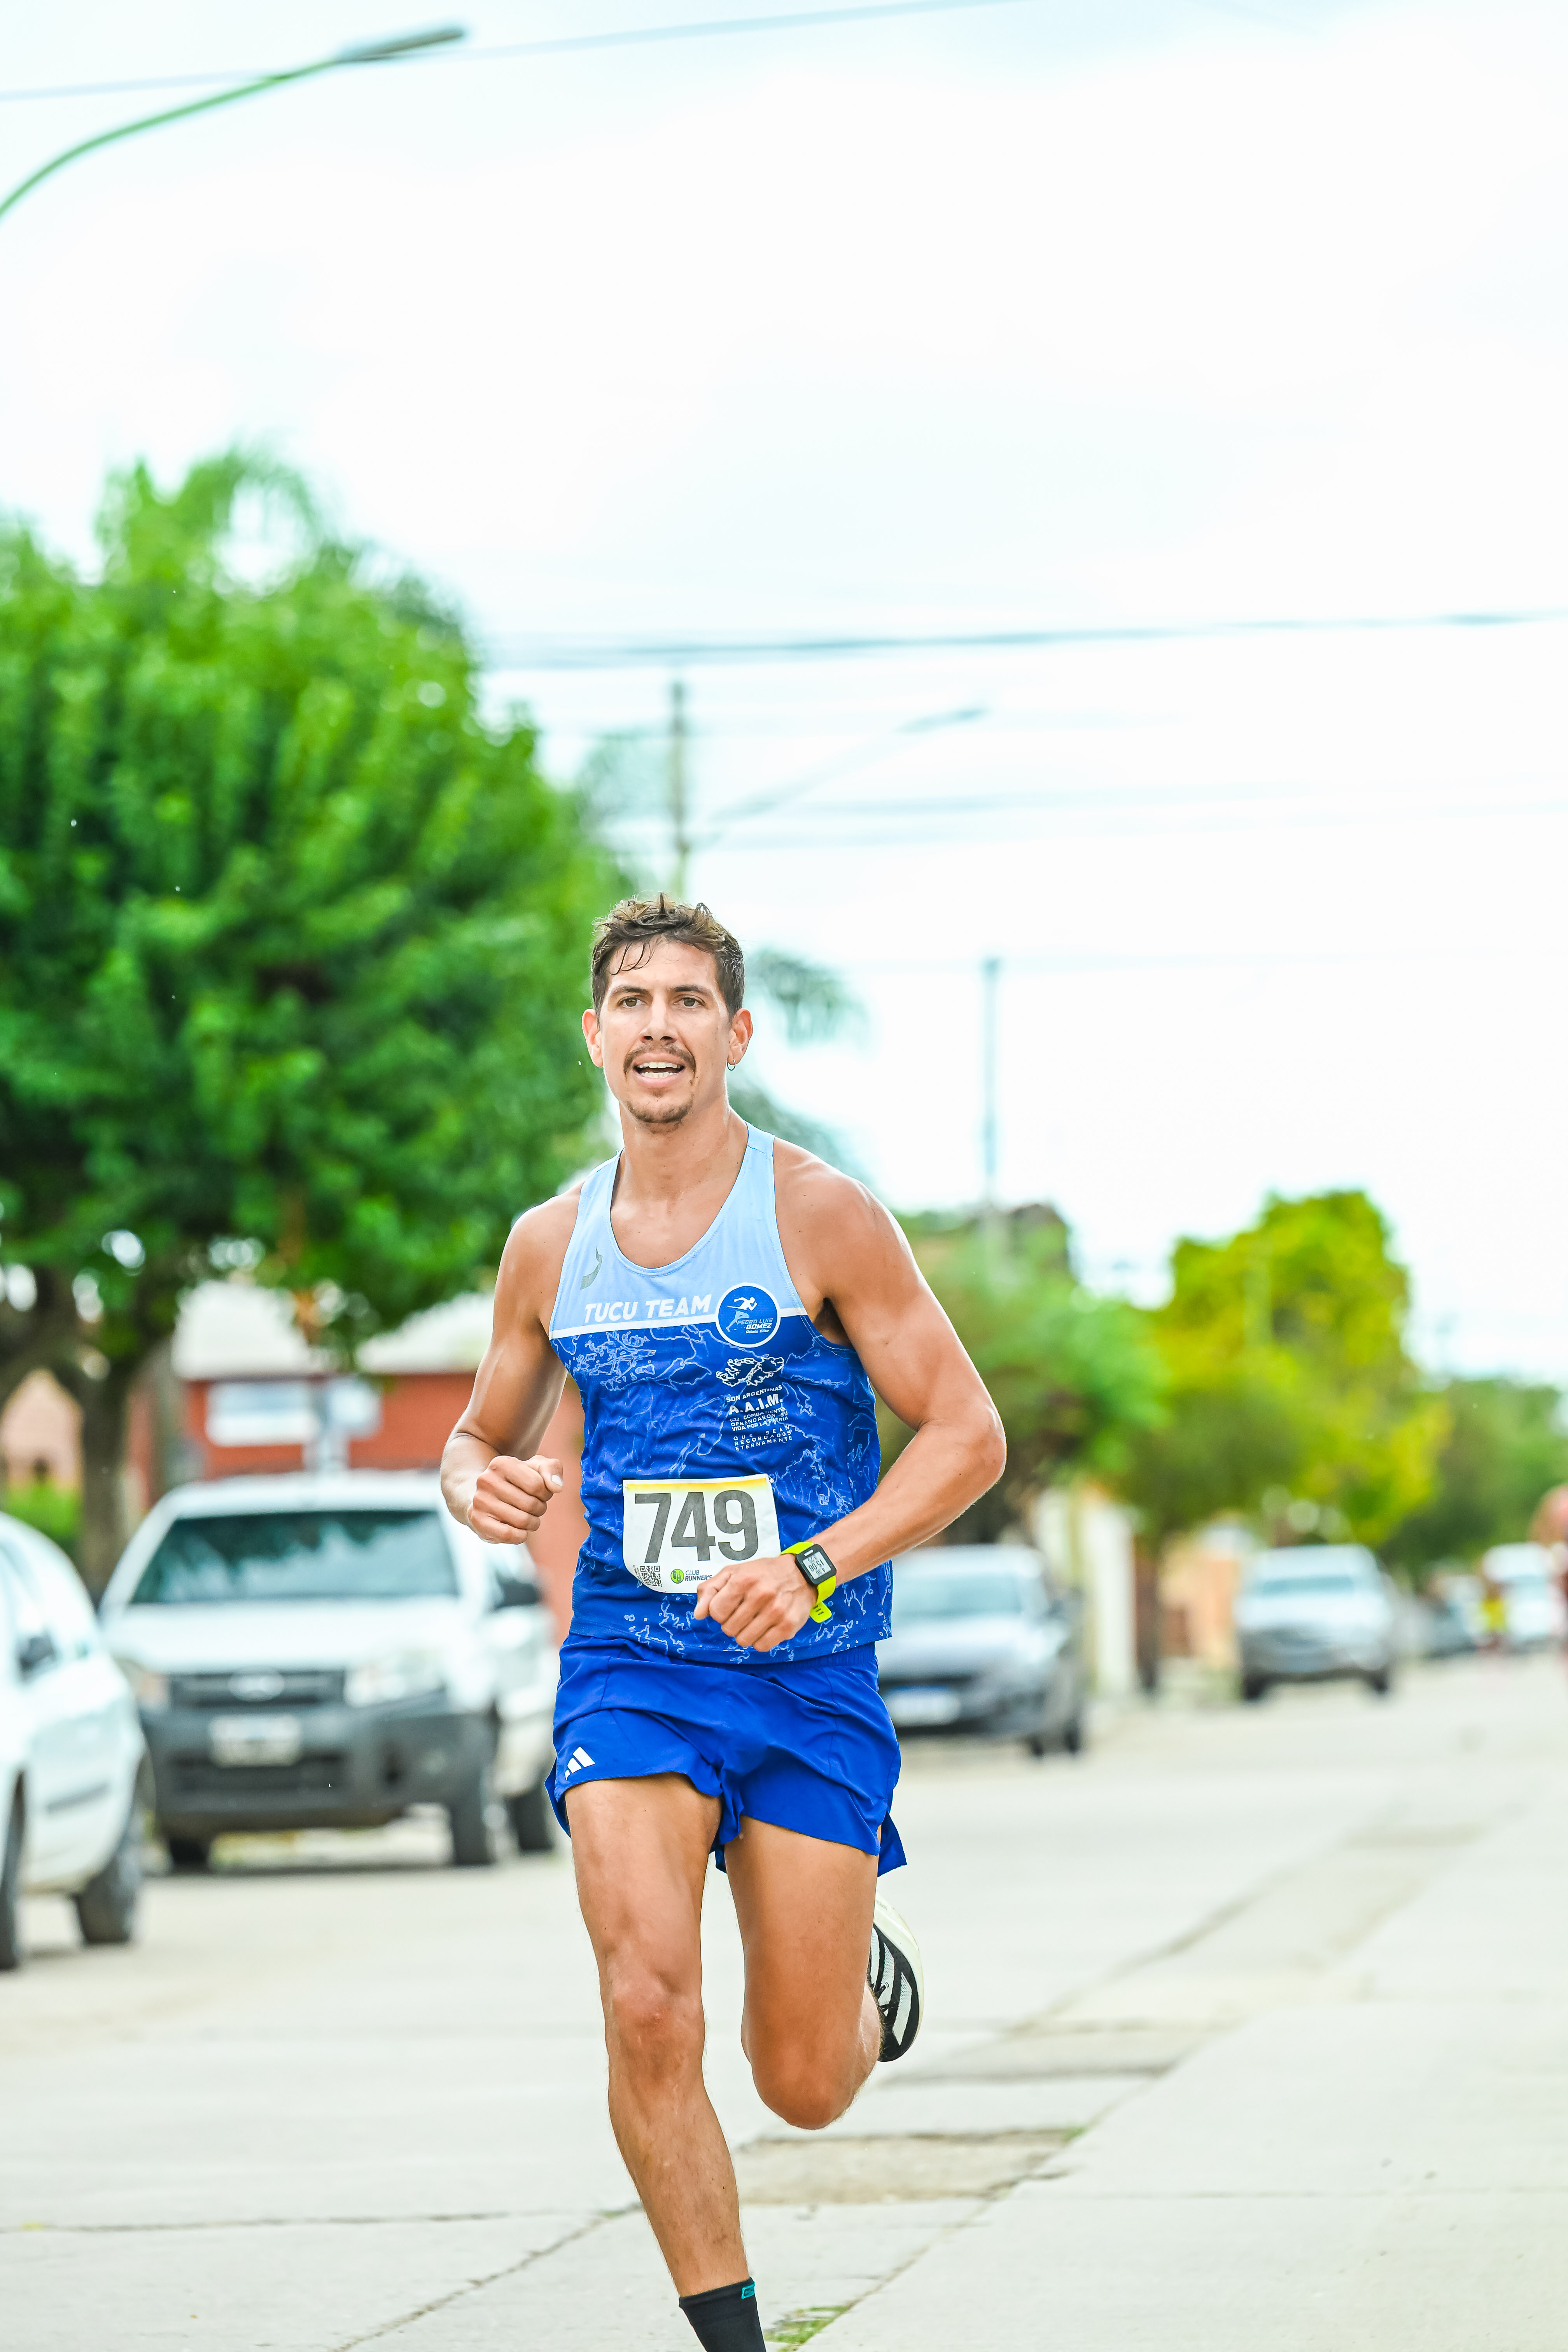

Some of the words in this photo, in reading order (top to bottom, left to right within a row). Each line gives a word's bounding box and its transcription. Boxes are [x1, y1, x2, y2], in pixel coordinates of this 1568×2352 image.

[584, 1302, 638, 1323] TUCU
[646, 1294, 712, 1318] TEAM
[742, 1385, 782, 1399] ARGENTINAS
[731, 1414, 775, 1426] OFRENDARON
[743, 1407, 786, 1419] COMBATIENTES
[766, 1425, 790, 1435] SEAN
[734, 1430, 792, 1446] RECORDADOS
[735, 1435, 793, 1451] ETERNAMENTE
[635, 1490, 758, 1563] 749
